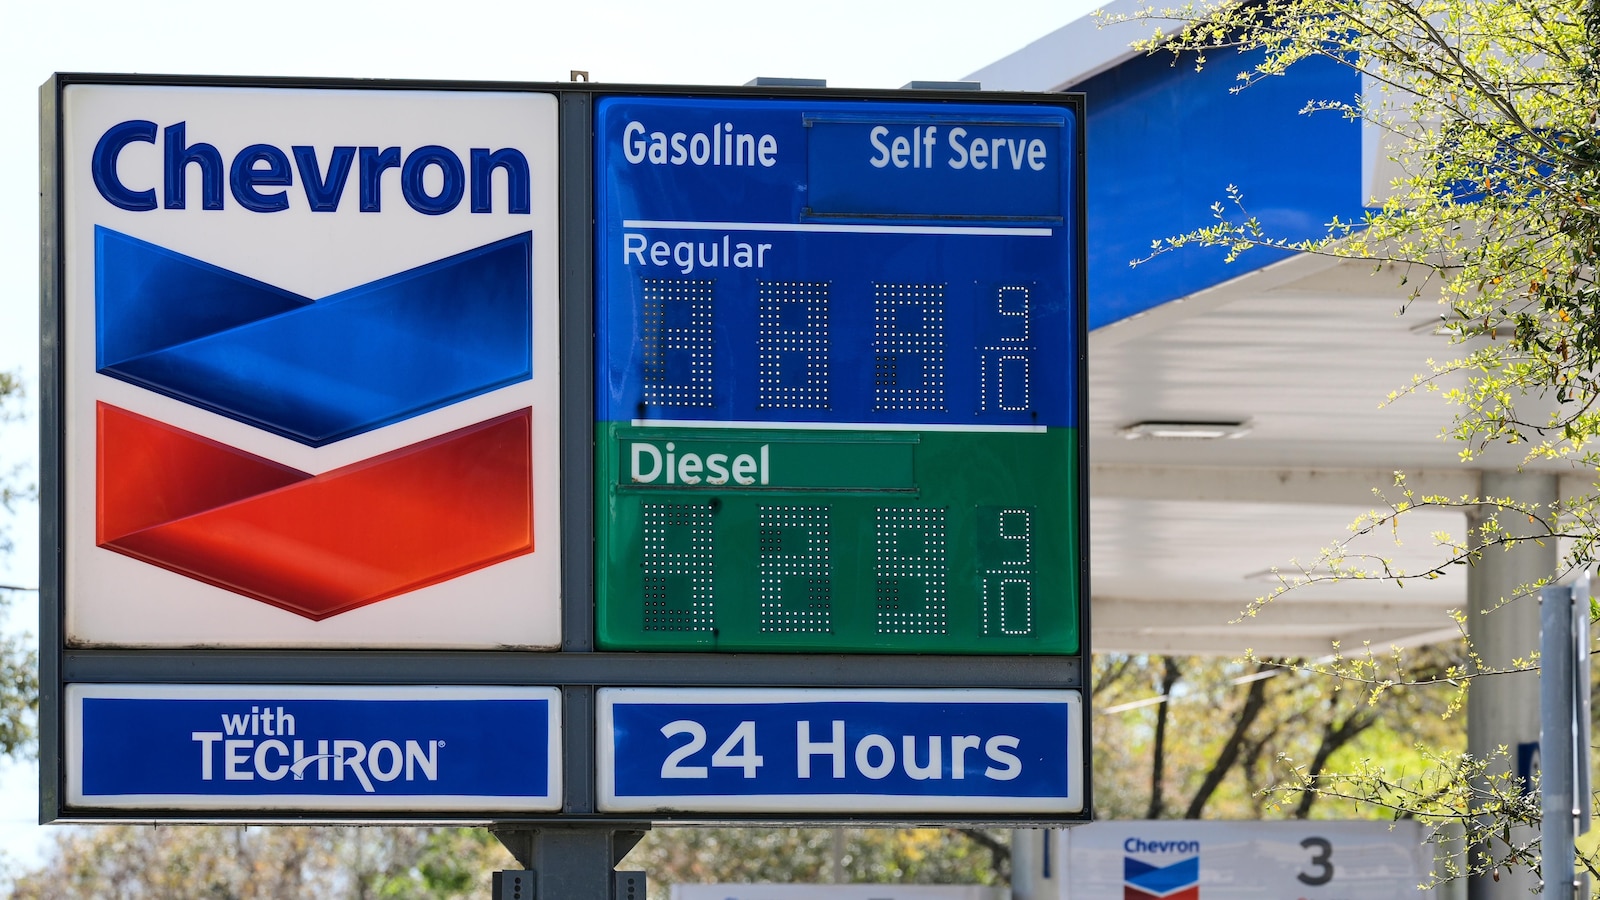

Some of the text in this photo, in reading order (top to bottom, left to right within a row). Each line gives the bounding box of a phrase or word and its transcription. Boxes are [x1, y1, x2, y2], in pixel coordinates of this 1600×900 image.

[622, 120, 778, 168] Gasoline
[869, 125, 1048, 171] Self Serve
[92, 119, 532, 216] Chevron
[622, 233, 772, 274] Regular
[630, 442, 771, 486] Diesel
[221, 706, 296, 736] with
[660, 719, 1023, 782] 24 Hours
[1123, 837, 1200, 854] Chevron
[1297, 836, 1335, 887] 3
